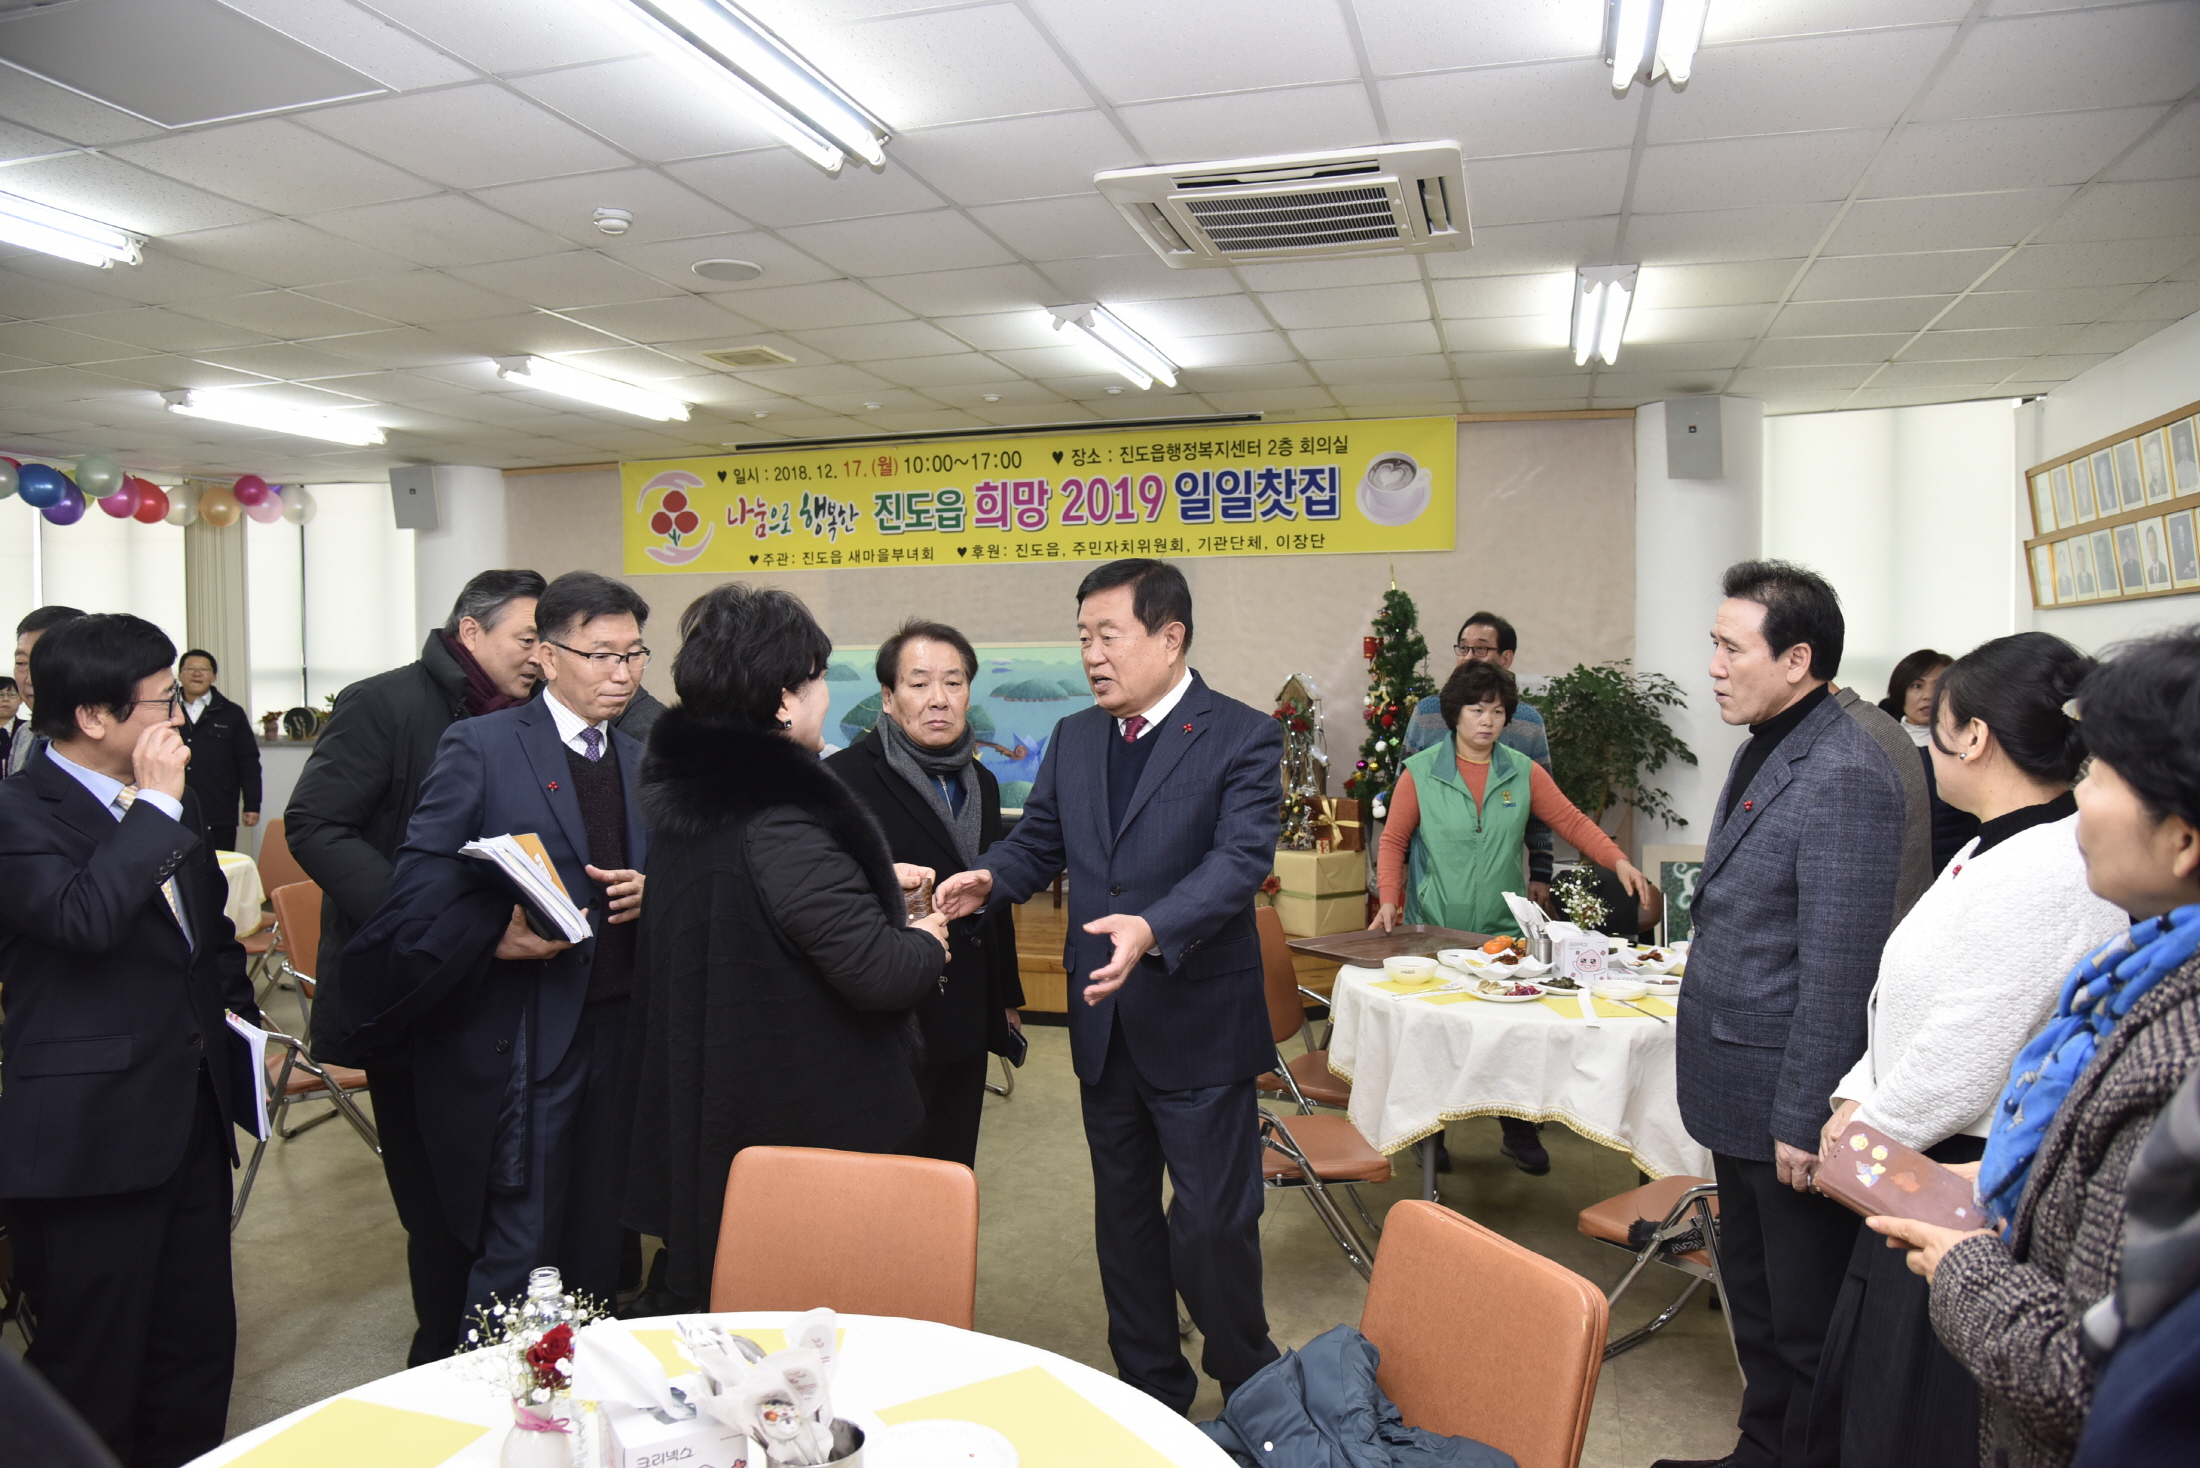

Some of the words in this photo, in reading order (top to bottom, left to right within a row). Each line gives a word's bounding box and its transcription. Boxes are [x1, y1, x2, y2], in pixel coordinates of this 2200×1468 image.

[1071, 447, 1102, 467] 장소
[1119, 438, 1262, 464] 진도읍행정복지센터
[1267, 437, 1294, 457] 2층
[1299, 434, 1348, 456] 회의실
[733, 467, 759, 485] 일시
[773, 465, 812, 482] 2018.
[816, 463, 838, 479] 12.
[843, 459, 867, 478] 17.
[871, 456, 899, 478] (월)
[904, 450, 1023, 474] 10:00~17:00
[727, 496, 792, 539] 나눔으로
[799, 491, 860, 543] 행복한
[873, 488, 965, 533] 진도읍
[974, 479, 1050, 529] 희망
[1060, 474, 1164, 523] 2019
[1173, 466, 1338, 521] 일일찻집
[762, 552, 796, 567] 주관:
[802, 550, 843, 565] 진도읍
[848, 546, 935, 564] 새마을부녀회
[971, 543, 1007, 559] 후원:
[1015, 541, 1066, 558] 진도읍,
[1072, 537, 1190, 556] 주민자치위원회,
[1198, 535, 1268, 552] 기관단체,
[1276, 533, 1326, 550] 이장단
[637, 1446, 694, 1468] 크리넥스
